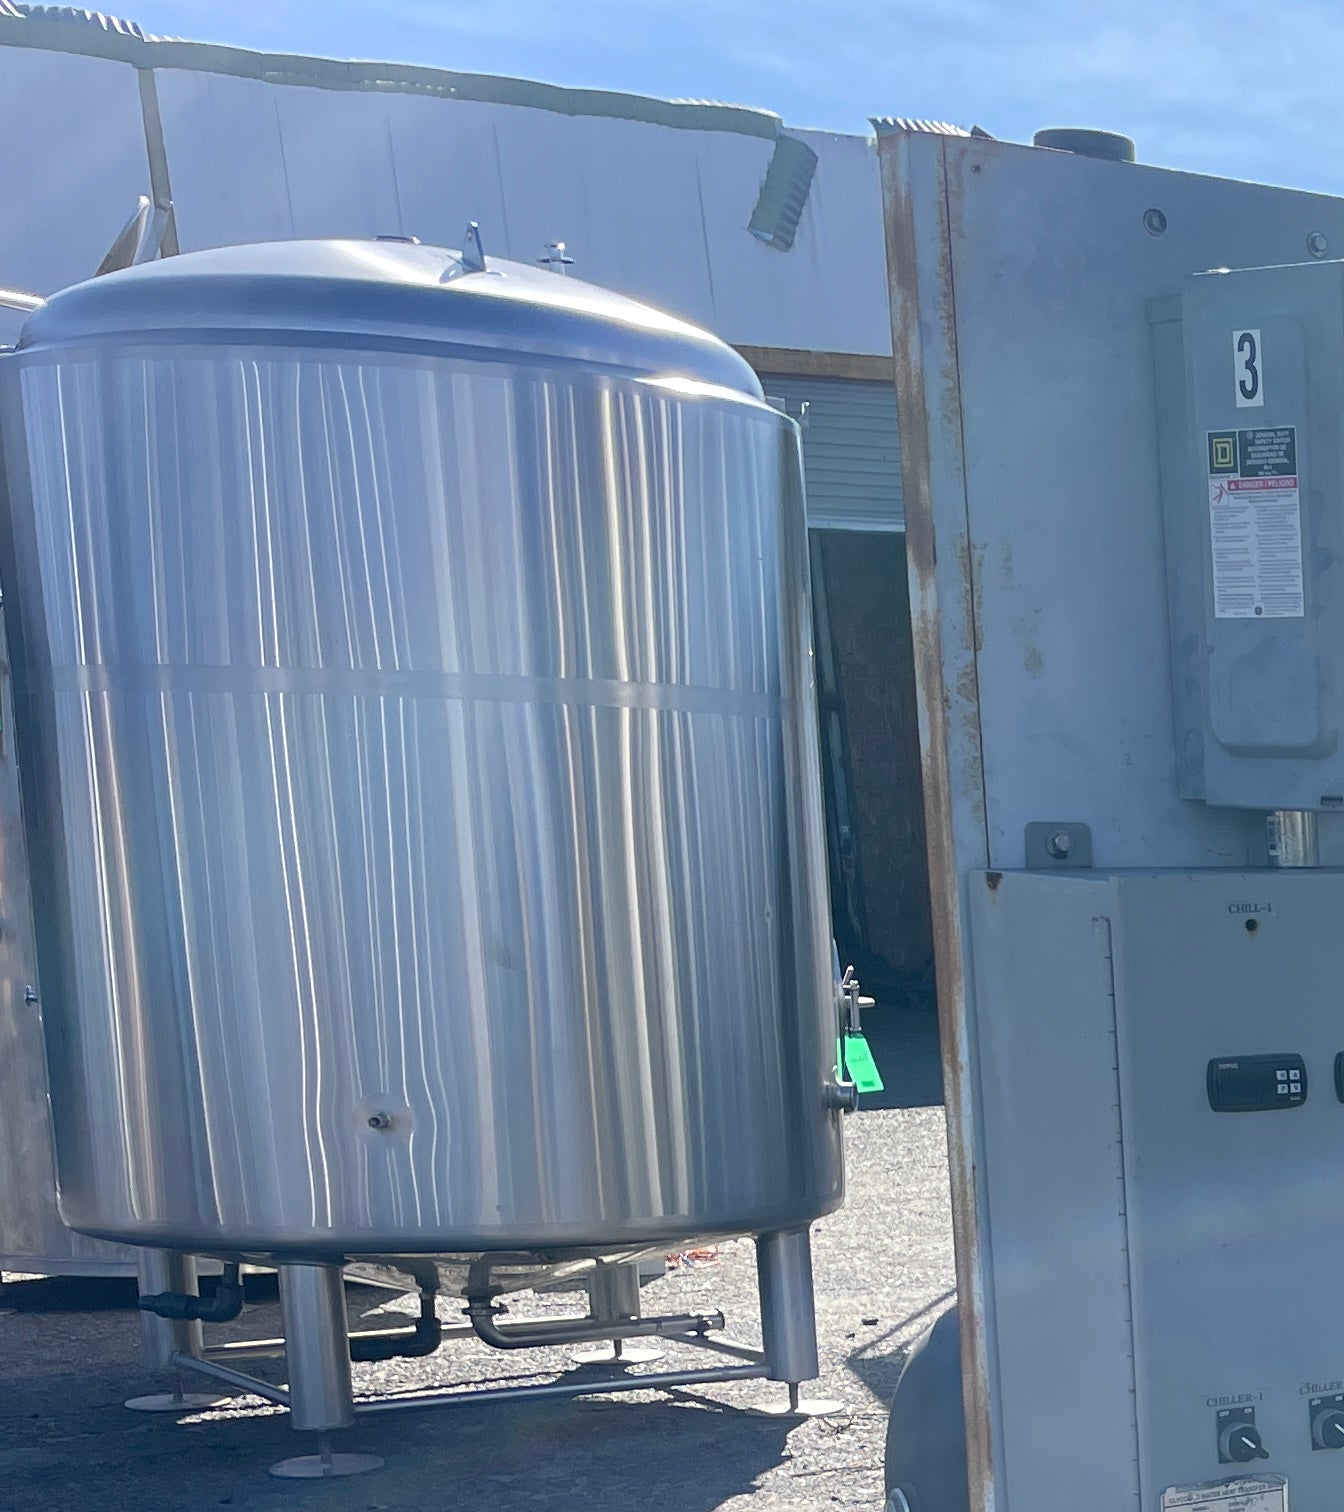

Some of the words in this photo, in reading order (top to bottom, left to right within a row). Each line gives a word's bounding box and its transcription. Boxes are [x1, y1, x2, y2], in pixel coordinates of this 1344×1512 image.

[1237, 332, 1260, 401] 3
[1228, 902, 1272, 914] CHILL-1
[1206, 1392, 1263, 1408] CHILLER-1
